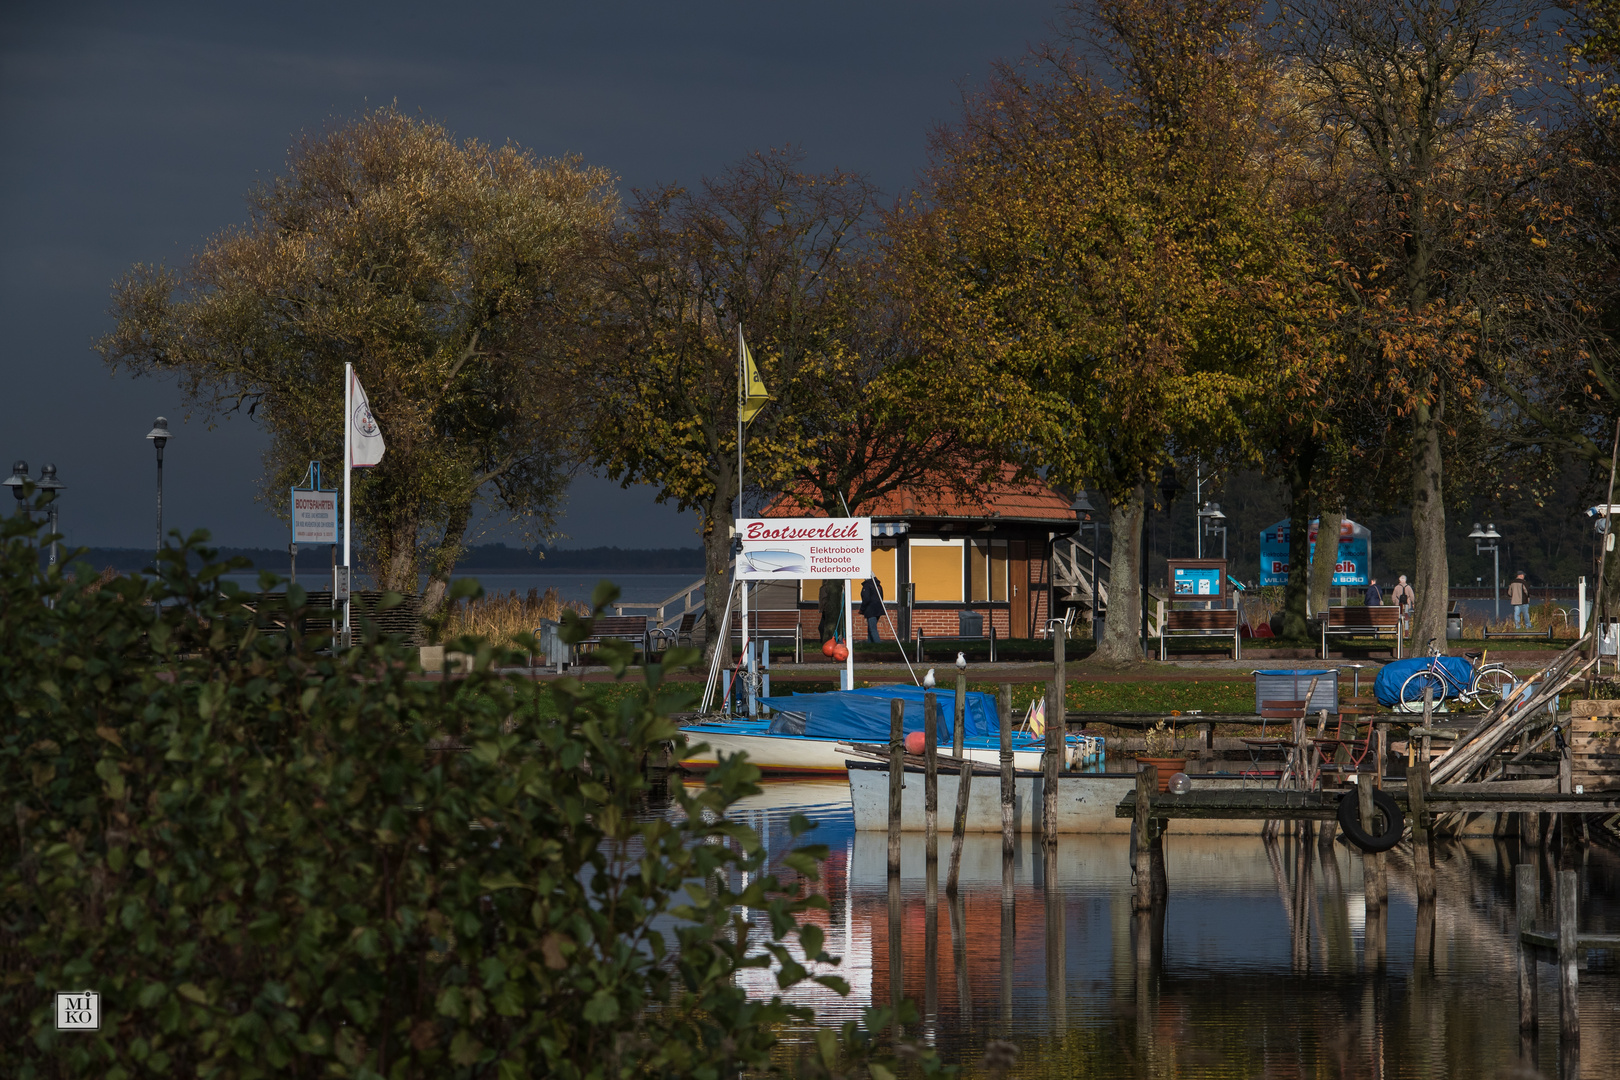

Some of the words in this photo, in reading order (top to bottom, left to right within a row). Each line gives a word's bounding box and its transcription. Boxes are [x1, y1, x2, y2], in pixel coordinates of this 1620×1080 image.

[295, 499, 334, 510] BOOTSFAHRTEN
[747, 522, 859, 539] Bootsverleih
[810, 546, 865, 554] Elektroboote
[810, 556, 852, 564] Tretboote
[810, 565, 860, 573] Ruderboote
